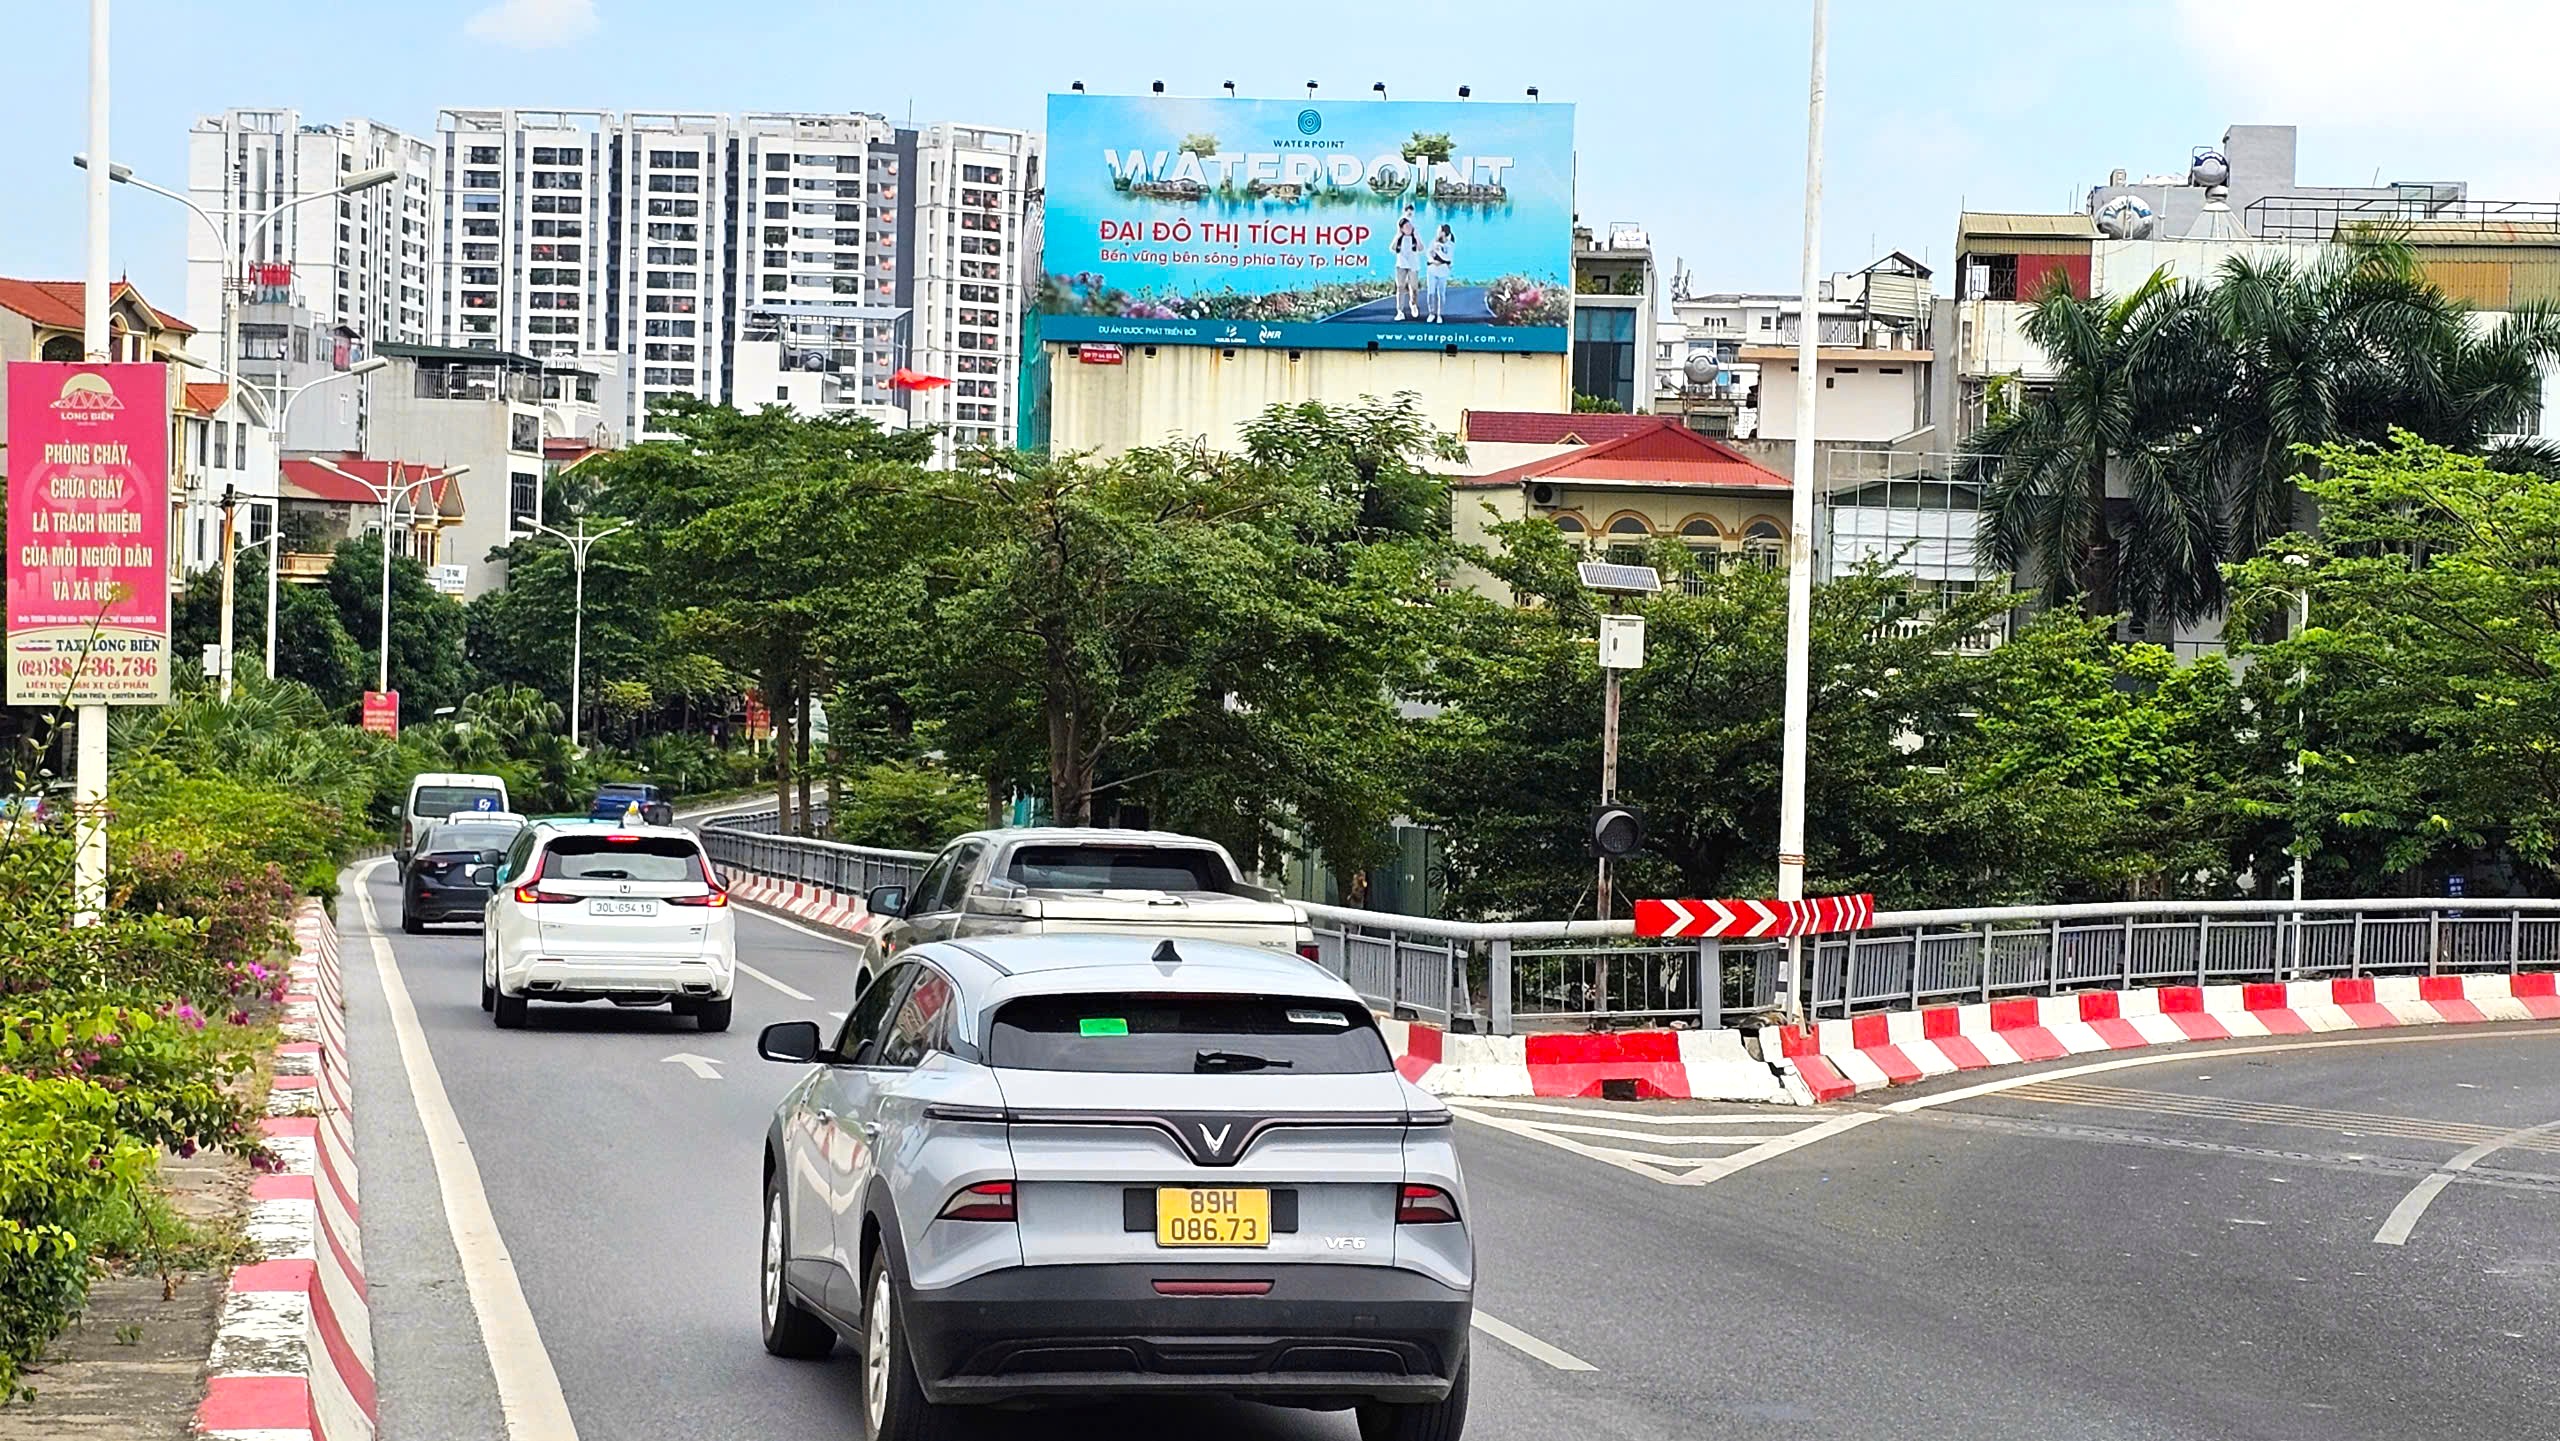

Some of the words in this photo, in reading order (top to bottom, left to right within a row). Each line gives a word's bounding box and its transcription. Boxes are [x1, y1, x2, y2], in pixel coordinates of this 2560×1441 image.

[1273, 139, 1345, 149] WATERPOINT
[1103, 149, 1515, 197] WATERPOINT
[1100, 220, 1142, 246] ĐẠI
[1152, 217, 1192, 242] ĐÔ
[1200, 223, 1238, 249] THỊ
[1247, 219, 1306, 245] TÍCH
[1316, 224, 1370, 251] HỢP
[1132, 250, 1167, 265] vững
[1173, 250, 1200, 263] bên
[1204, 252, 1239, 266] sông
[1243, 253, 1276, 267] phía
[1279, 253, 1304, 268] Tây
[1334, 254, 1368, 266] HCM
[1376, 331, 1515, 344] www.waterpoint.com.vn
[61, 412, 89, 421] LONG
[90, 410, 115, 421] BIÊN
[45, 439, 90, 465] PHÒNG
[93, 439, 132, 468] CHÁY,
[51, 474, 86, 499] CHỮA
[90, 474, 124, 499] CHÁY
[32, 508, 49, 533] LÀ
[52, 508, 95, 533] TRÁCH
[98, 508, 142, 537] NHIỆM
[22, 539, 48, 567] CỦA
[52, 539, 78, 567] MỖI
[81, 541, 121, 567] NGƯỜI
[125, 541, 153, 567] DÂN
[53, 576, 71, 601] VÀ
[73, 577, 91, 601] XÃ
[92, 638, 127, 652] LONG
[130, 635, 161, 652] BIÊN
[1190, 1189, 1237, 1215] 89H
[1170, 1217, 1257, 1242] 086.73
